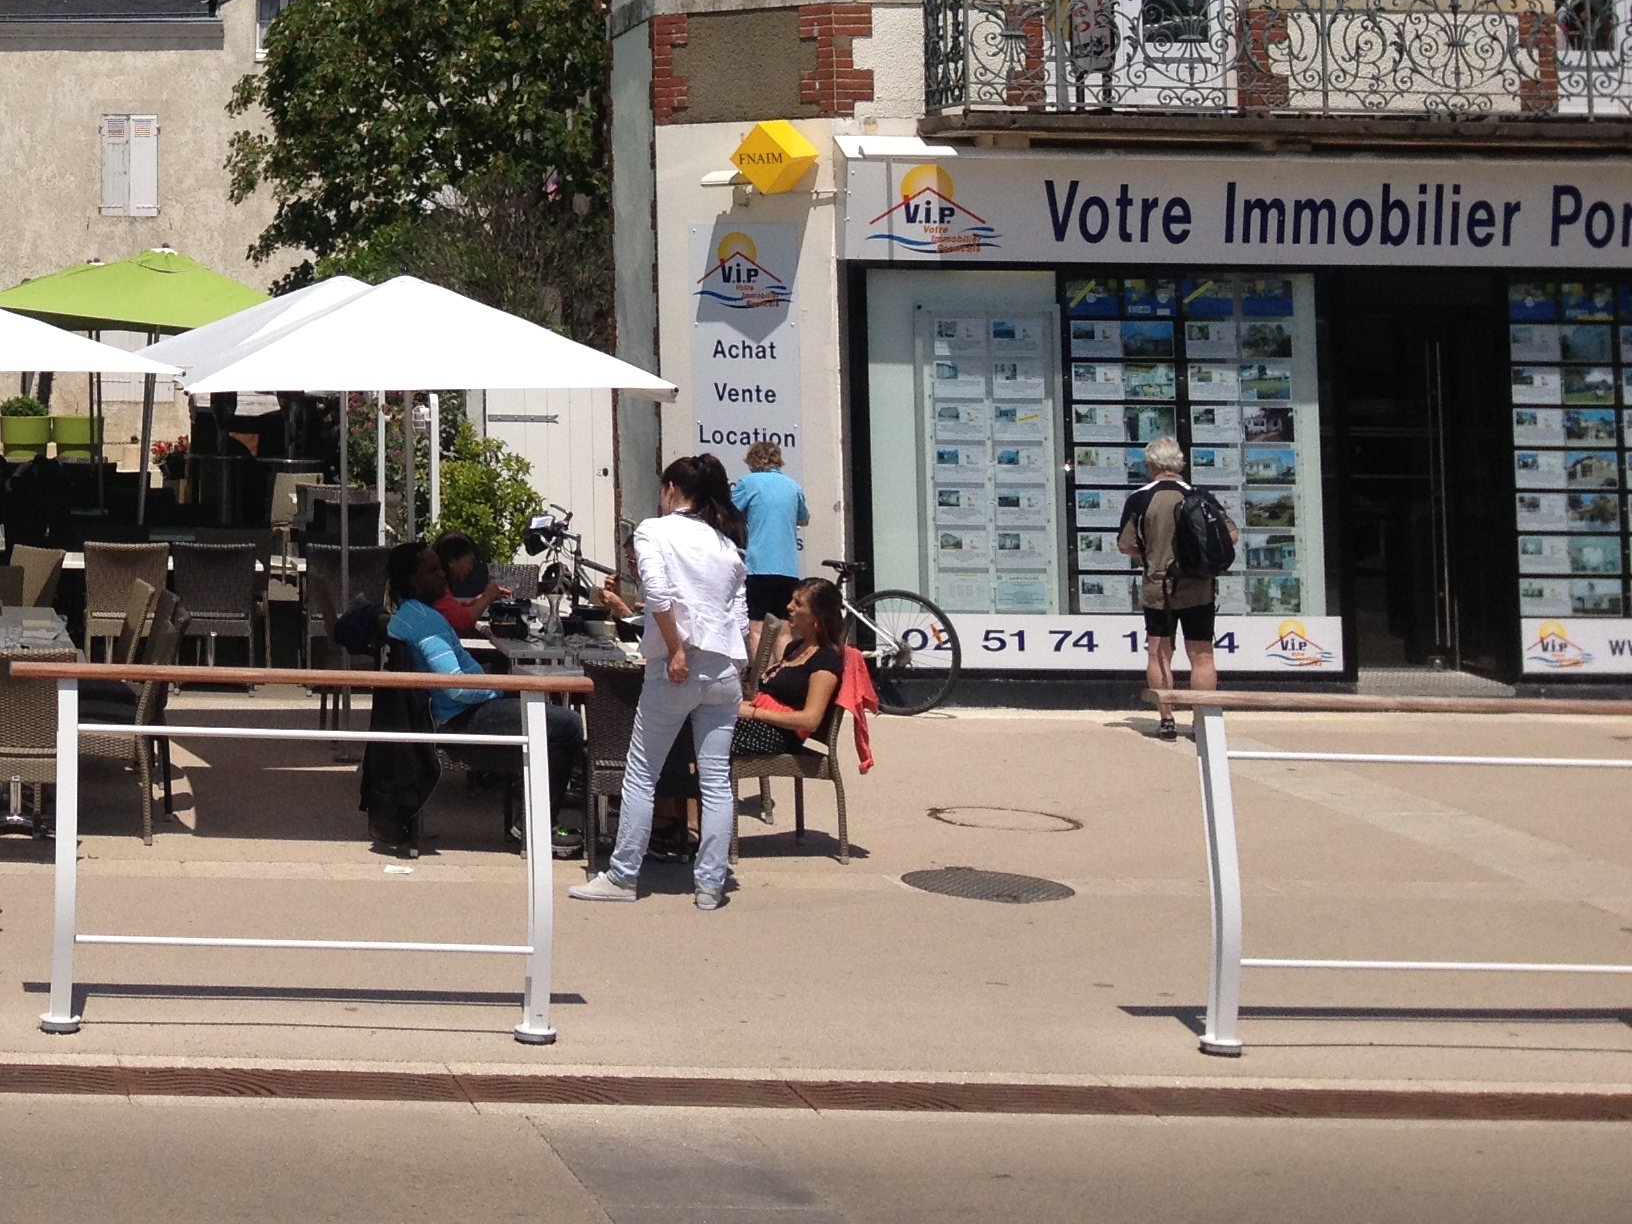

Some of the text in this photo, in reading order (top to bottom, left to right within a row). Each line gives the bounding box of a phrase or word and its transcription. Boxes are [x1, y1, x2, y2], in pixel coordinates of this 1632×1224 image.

[738, 152, 783, 165] FNAIM
[1044, 179, 1192, 245] Votre
[1224, 180, 1522, 248] Immobilier
[923, 225, 949, 234] Votre
[712, 339, 777, 360] Achat
[714, 382, 777, 404] Vente
[699, 424, 796, 447] Location
[981, 629, 1026, 652] 51
[1048, 630, 1099, 652] 74
